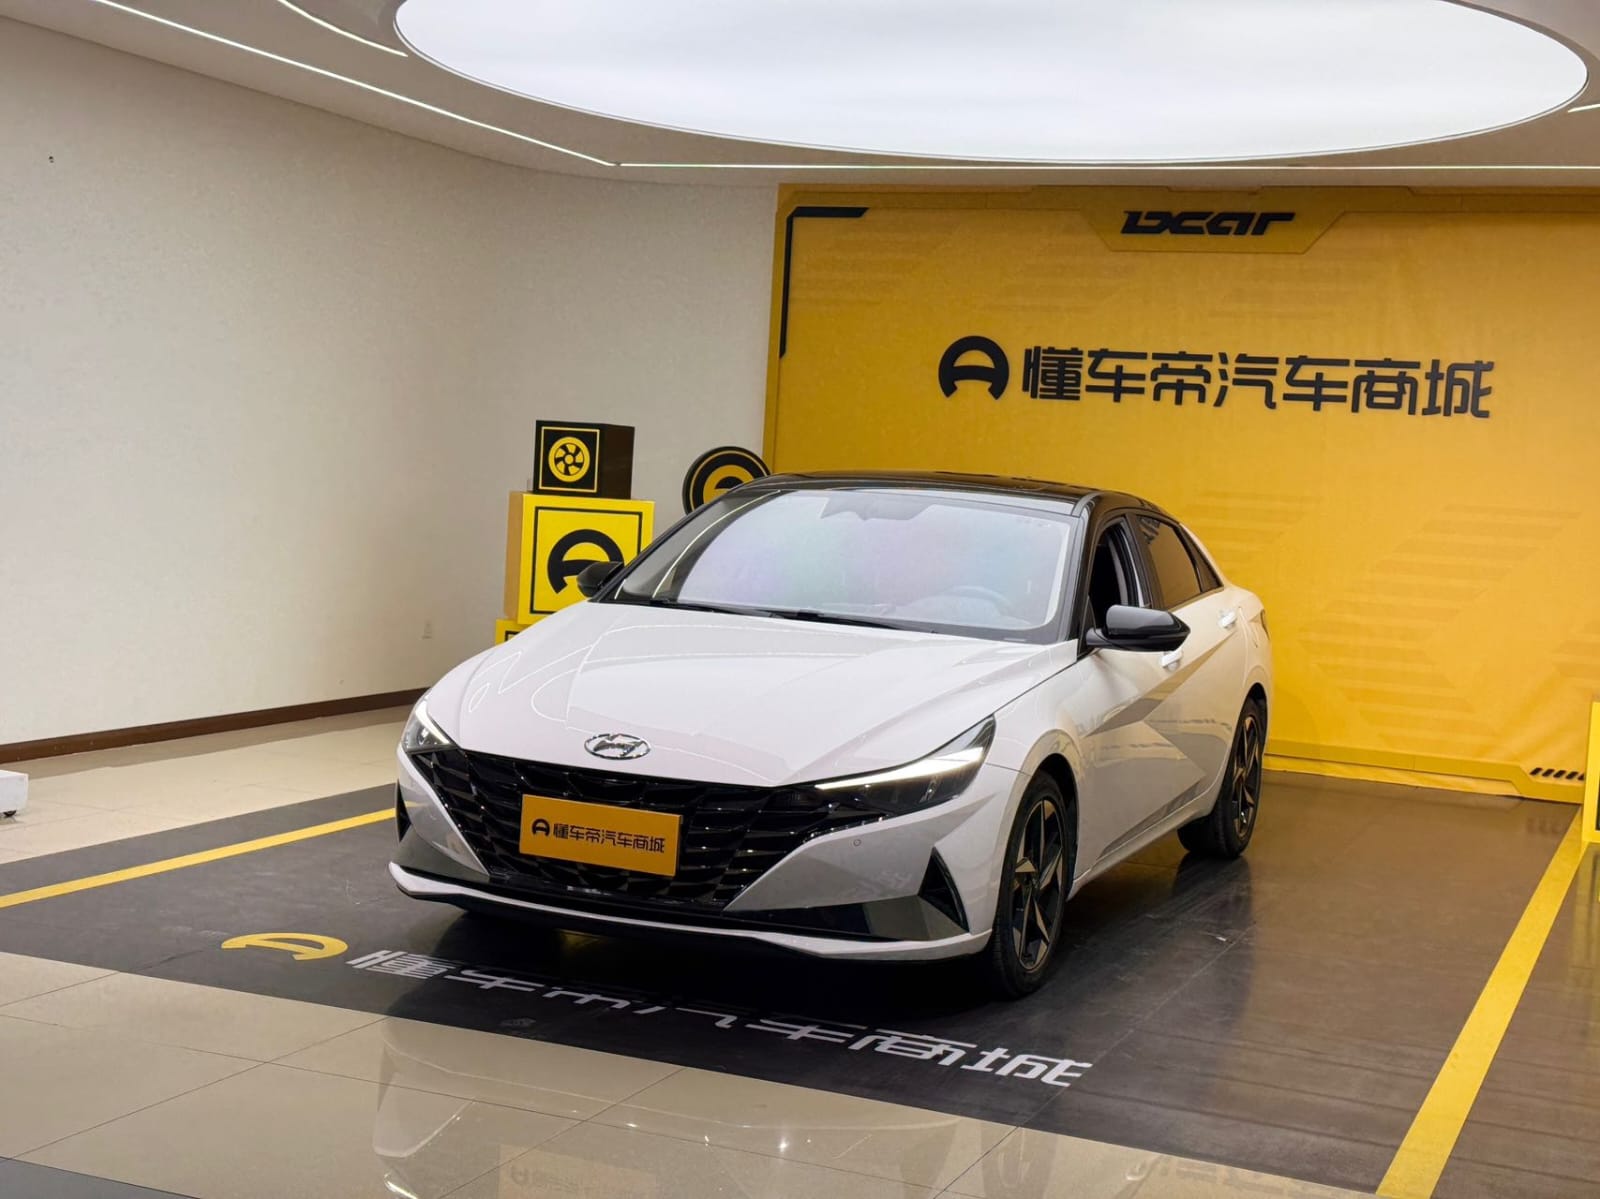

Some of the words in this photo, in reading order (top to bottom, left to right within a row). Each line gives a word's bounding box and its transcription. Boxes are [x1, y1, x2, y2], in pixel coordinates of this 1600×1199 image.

[1022, 346, 1495, 418] 懂车帝汽车商城
[553, 823, 666, 853] 懂车帝汽车商城
